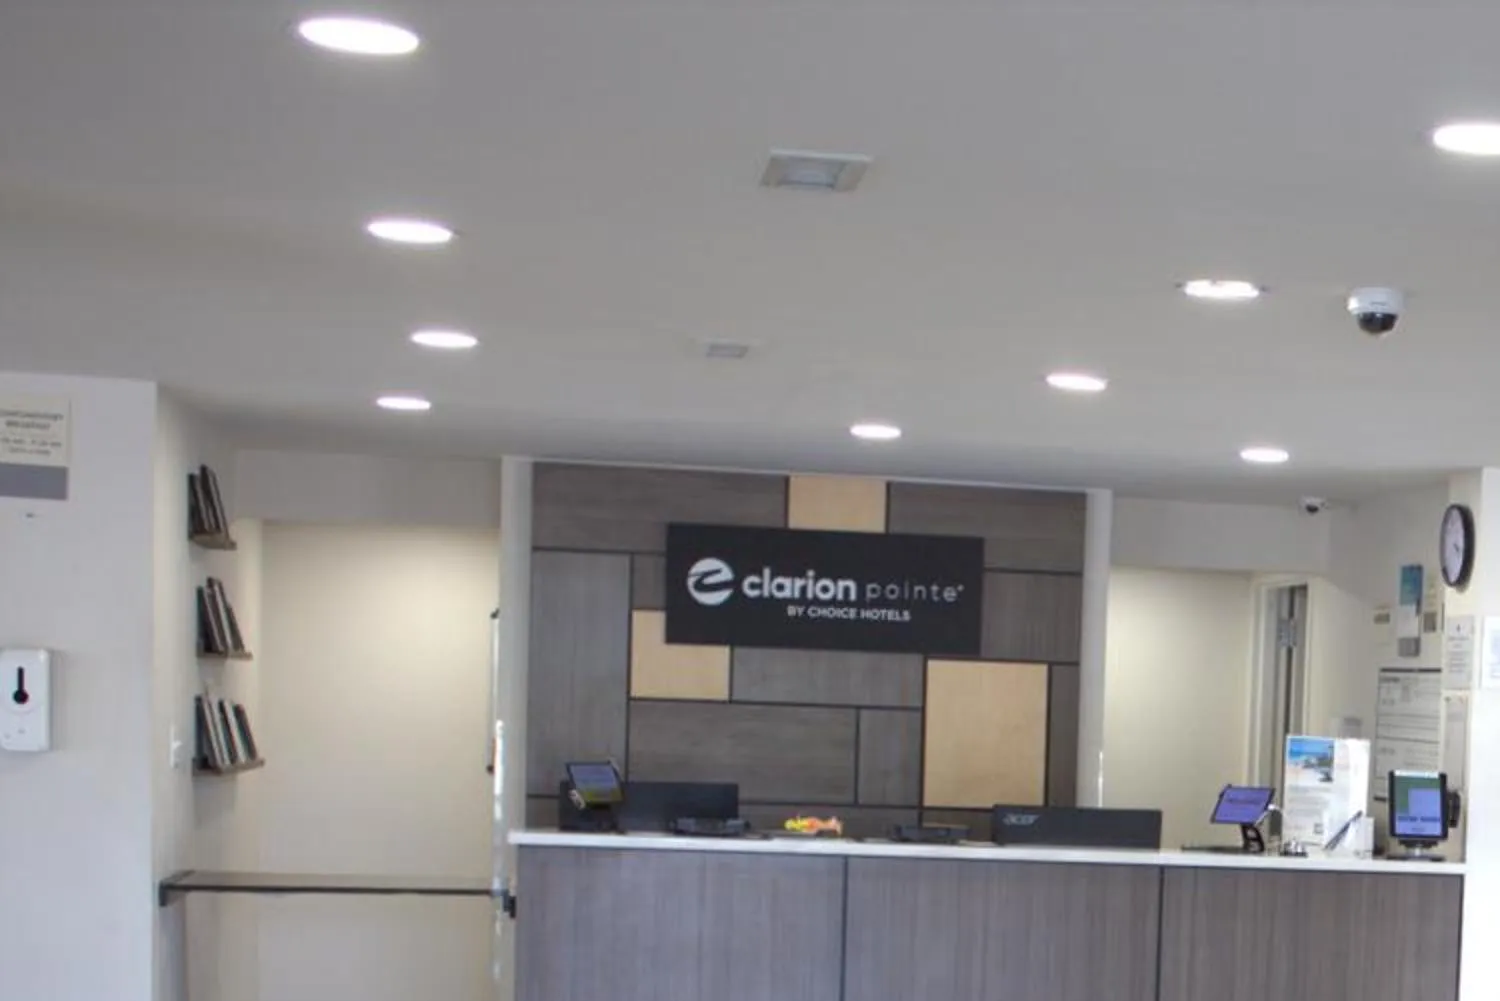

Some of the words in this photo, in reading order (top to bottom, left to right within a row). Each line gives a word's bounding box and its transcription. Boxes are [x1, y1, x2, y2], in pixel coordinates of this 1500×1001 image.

[742, 566, 857, 602] clarion
[864, 579, 957, 603] pointe
[786, 604, 804, 617] BY
[807, 606, 857, 620] CHOICE
[860, 608, 911, 622] HOTELS
